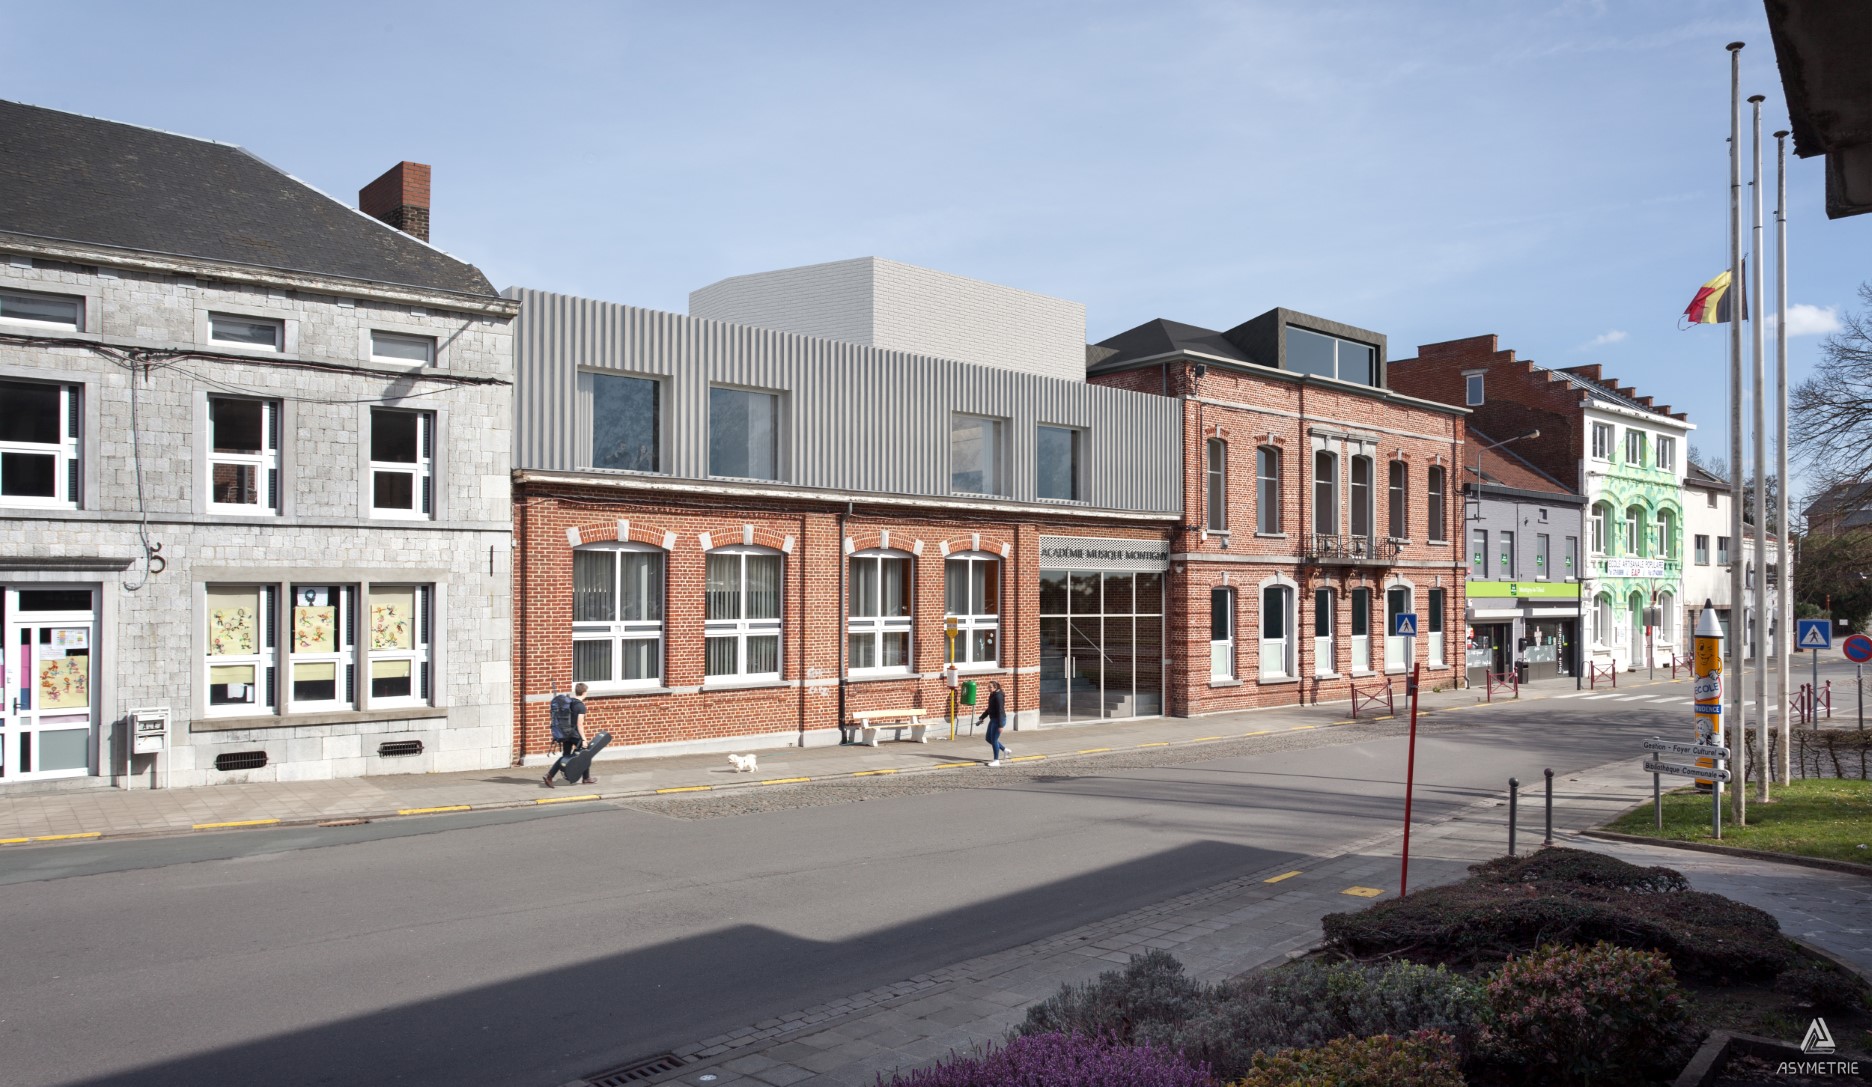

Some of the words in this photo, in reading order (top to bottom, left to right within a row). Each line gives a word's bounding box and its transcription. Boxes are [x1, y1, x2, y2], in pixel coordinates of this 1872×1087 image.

[1041, 546, 1083, 558] ACADÉMIE
[1087, 549, 1123, 561] MUSIQUE
[1125, 550, 1168, 561] MONTIGNY
[1695, 682, 1719, 695] ECOLE
[1643, 741, 1666, 750] Gestion
[1672, 745, 1691, 755] Foyer
[1692, 747, 1717, 756] Culturel
[1682, 767, 1718, 778] Communale
